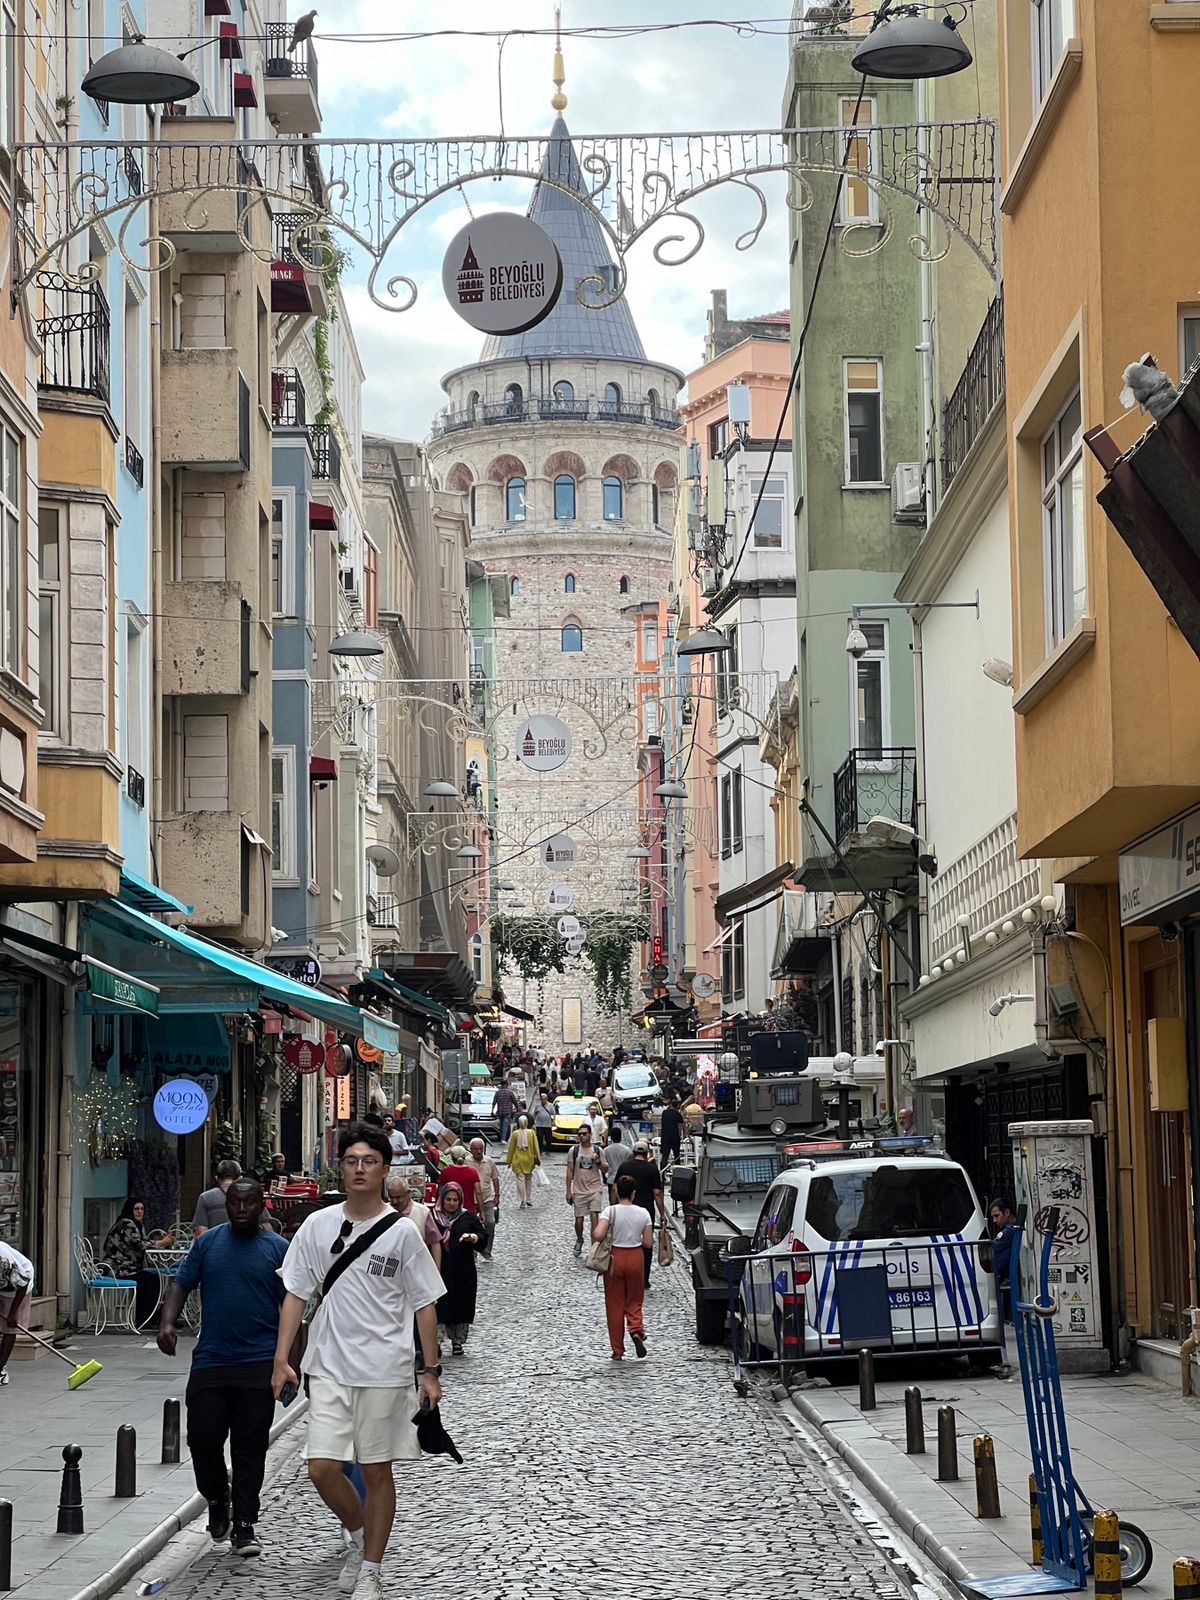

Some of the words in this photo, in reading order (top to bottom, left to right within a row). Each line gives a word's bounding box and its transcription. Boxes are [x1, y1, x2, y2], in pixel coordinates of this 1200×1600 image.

[270, 269, 294, 280] OUNGE
[490, 261, 544, 286] BEYOĞLU
[538, 737, 566, 749] BEYOĞLU
[159, 1091, 204, 1106] MOON
[165, 1115, 193, 1125] OTEL
